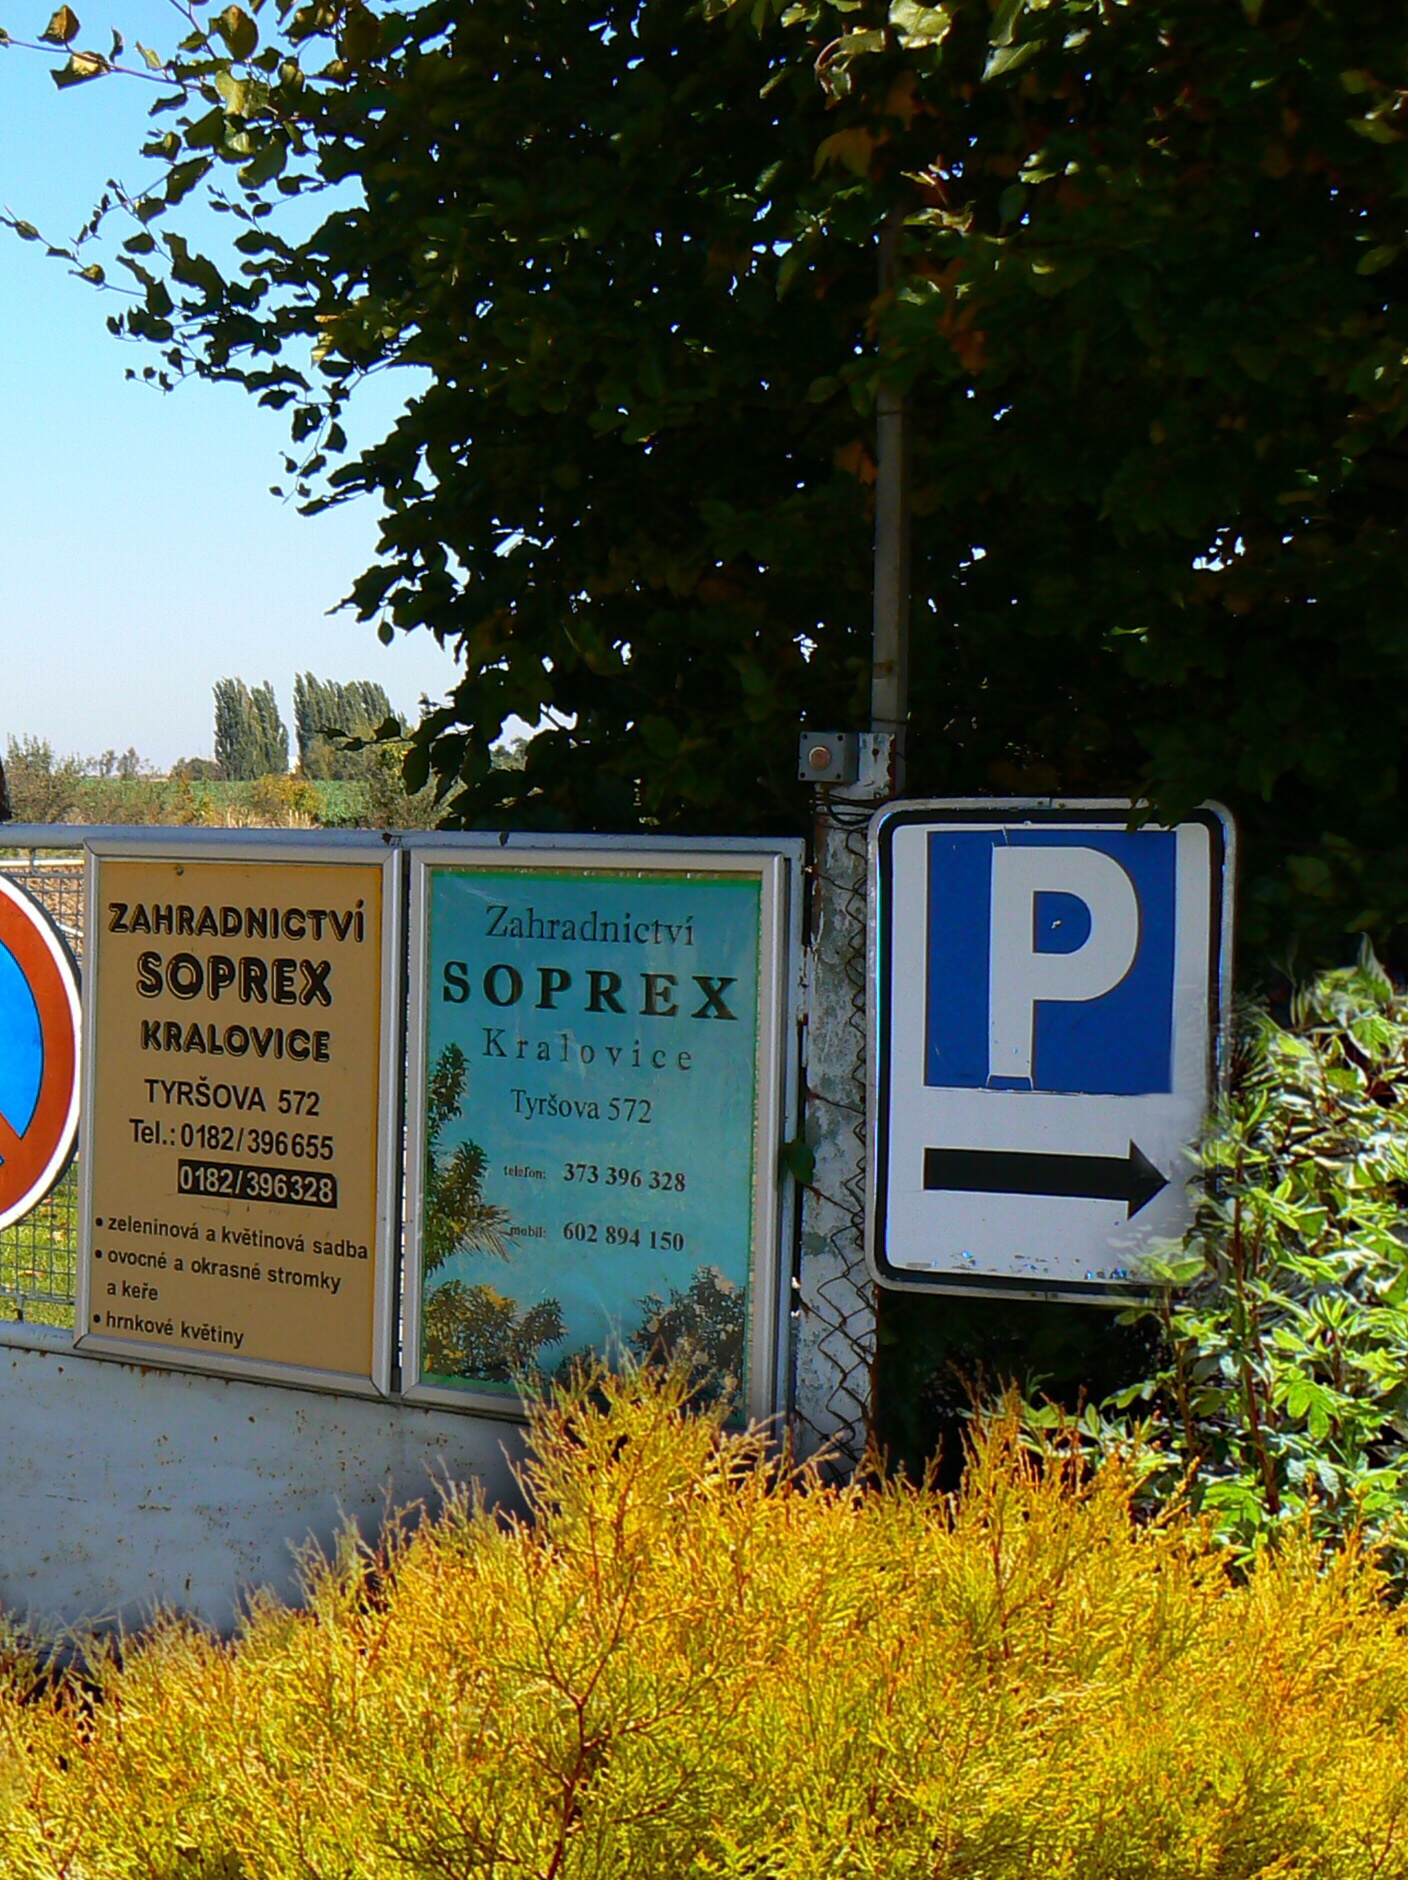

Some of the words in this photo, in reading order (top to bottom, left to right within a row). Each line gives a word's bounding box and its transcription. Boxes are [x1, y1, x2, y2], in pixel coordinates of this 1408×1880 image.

[108, 899, 365, 943] ZAHRADNICTVÍ
[485, 905, 694, 946] Zahradnictví
[136, 950, 333, 1008] SOPREX
[988, 845, 1139, 1077] P
[442, 960, 739, 1021] SOPREX
[141, 1019, 331, 1062] KRALOVICE
[482, 1027, 693, 1071] Kralovice
[144, 1075, 267, 1112] TYRŠOVA
[277, 1089, 320, 1117] 572
[510, 1088, 600, 1120] Tyršova
[607, 1097, 652, 1124] 572
[504, 1165, 546, 1180] telefon:
[563, 1162, 599, 1184] 373
[605, 1166, 642, 1188] 396
[648, 1170, 686, 1192] 328
[107, 1216, 199, 1240] zeleninová
[205, 1227, 216, 1242] a
[221, 1226, 305, 1252] květinová
[312, 1240, 368, 1260] sadba
[510, 1225, 546, 1239] mobil:
[563, 1222, 598, 1243] 602
[605, 1225, 640, 1247] 894
[650, 1230, 684, 1251] 150
[106, 1281, 117, 1296] a
[122, 1279, 159, 1301] keře
[107, 1250, 167, 1270] ovocné
[173, 1257, 184, 1272] a
[191, 1257, 261, 1281] okrasné
[267, 1268, 342, 1295] stromky
[106, 1311, 174, 1336] hrnkové
[180, 1321, 244, 1349] květiny
